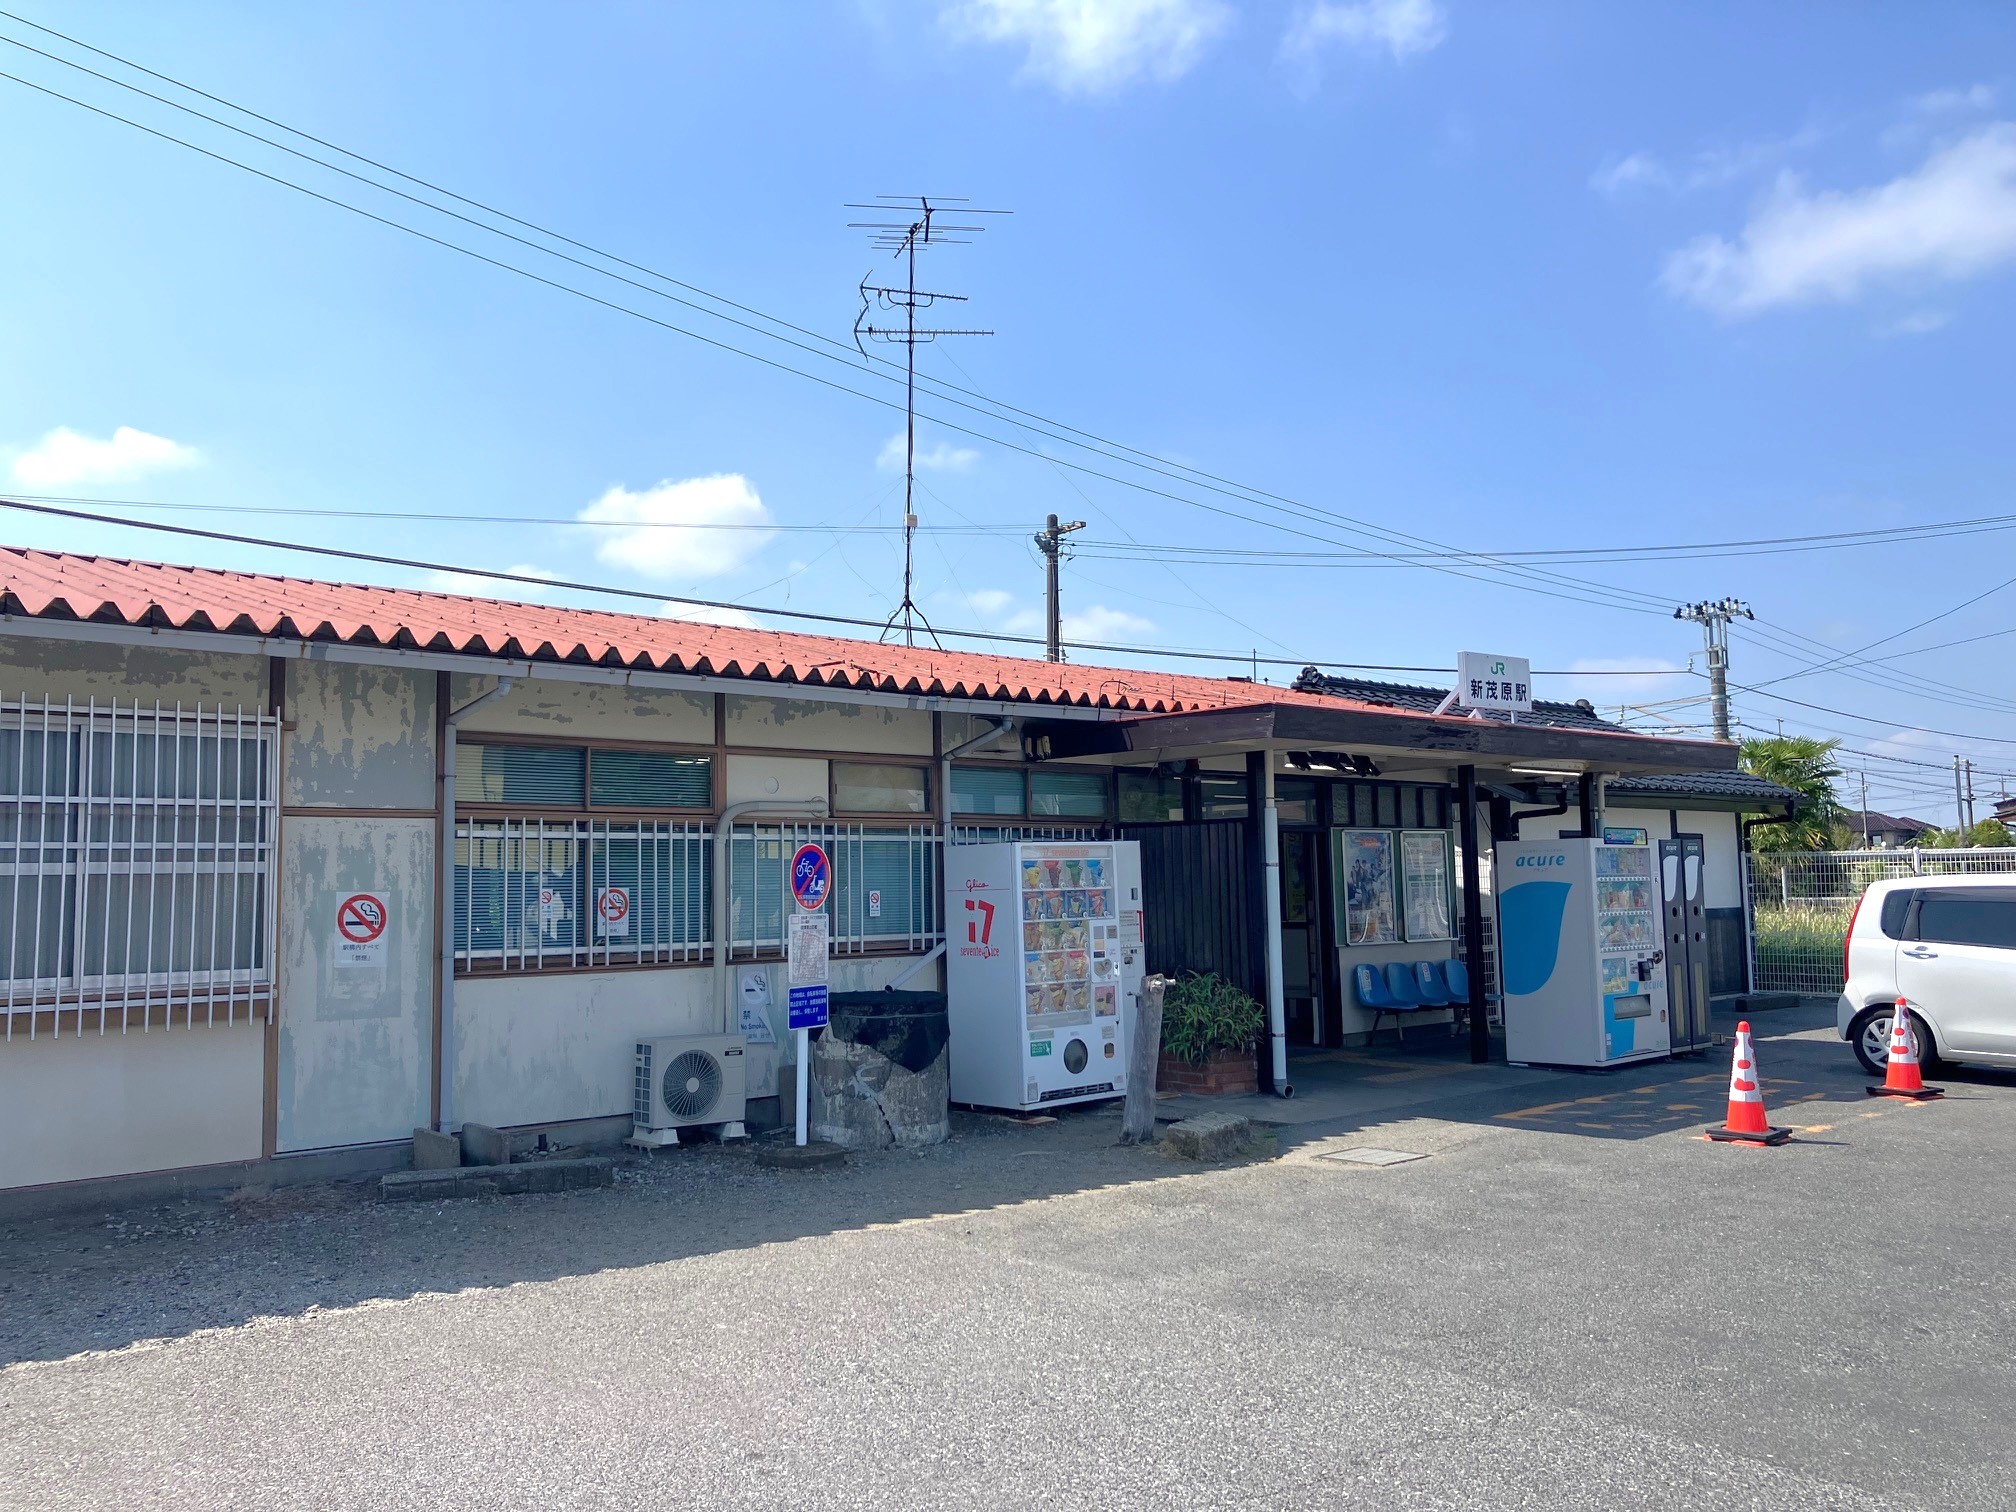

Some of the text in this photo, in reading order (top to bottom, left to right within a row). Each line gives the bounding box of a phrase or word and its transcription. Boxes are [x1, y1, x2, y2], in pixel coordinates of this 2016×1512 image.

[1490, 662, 1505, 676] JR
[1470, 678, 1527, 702] 新茂原駅
[1515, 855, 1565, 867] acure
[965, 879, 989, 892] Glico
[743, 1010, 751, 1020] 禁
